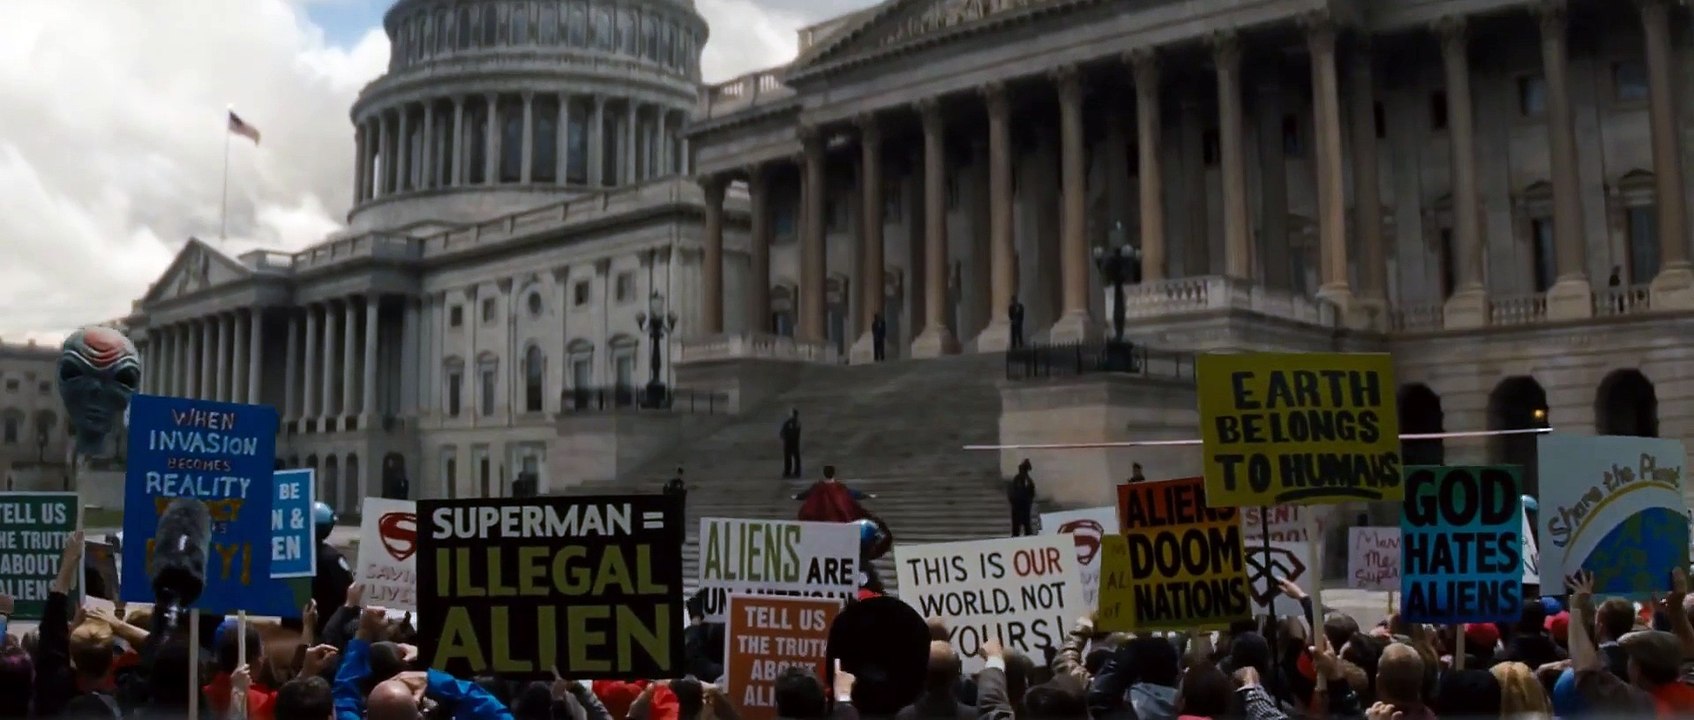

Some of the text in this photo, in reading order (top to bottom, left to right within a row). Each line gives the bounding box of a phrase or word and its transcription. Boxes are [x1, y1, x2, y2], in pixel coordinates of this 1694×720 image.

[1232, 370, 1382, 410] EARTH
[172, 407, 236, 430] WHEN
[1215, 410, 1379, 444] BELONGS
[149, 429, 258, 455] INVASION
[167, 457, 232, 472] BECOMES
[1214, 451, 1401, 493] TO HUMANS
[146, 471, 251, 499] REALITY
[276, 482, 300, 501] BE
[1404, 469, 1517, 527] GOD
[0, 502, 67, 525] ELL US
[432, 503, 632, 539] SUPERMAN
[1, 553, 60, 576] ABOUT
[704, 521, 853, 585] ALIENS ARE
[907, 546, 1064, 587] THIS IS OUR
[1128, 524, 1242, 580] DOOM
[1403, 531, 1521, 575] HATES
[436, 544, 669, 597] ILLEGAL
[1021, 581, 1066, 611] NOT
[1133, 577, 1248, 621] NATIONS
[1407, 579, 1518, 617] ALIENS
[744, 606, 827, 631] TELL US
[431, 603, 670, 673] ALIEN
[737, 635, 770, 655] THE
[743, 684, 776, 707] ALI
